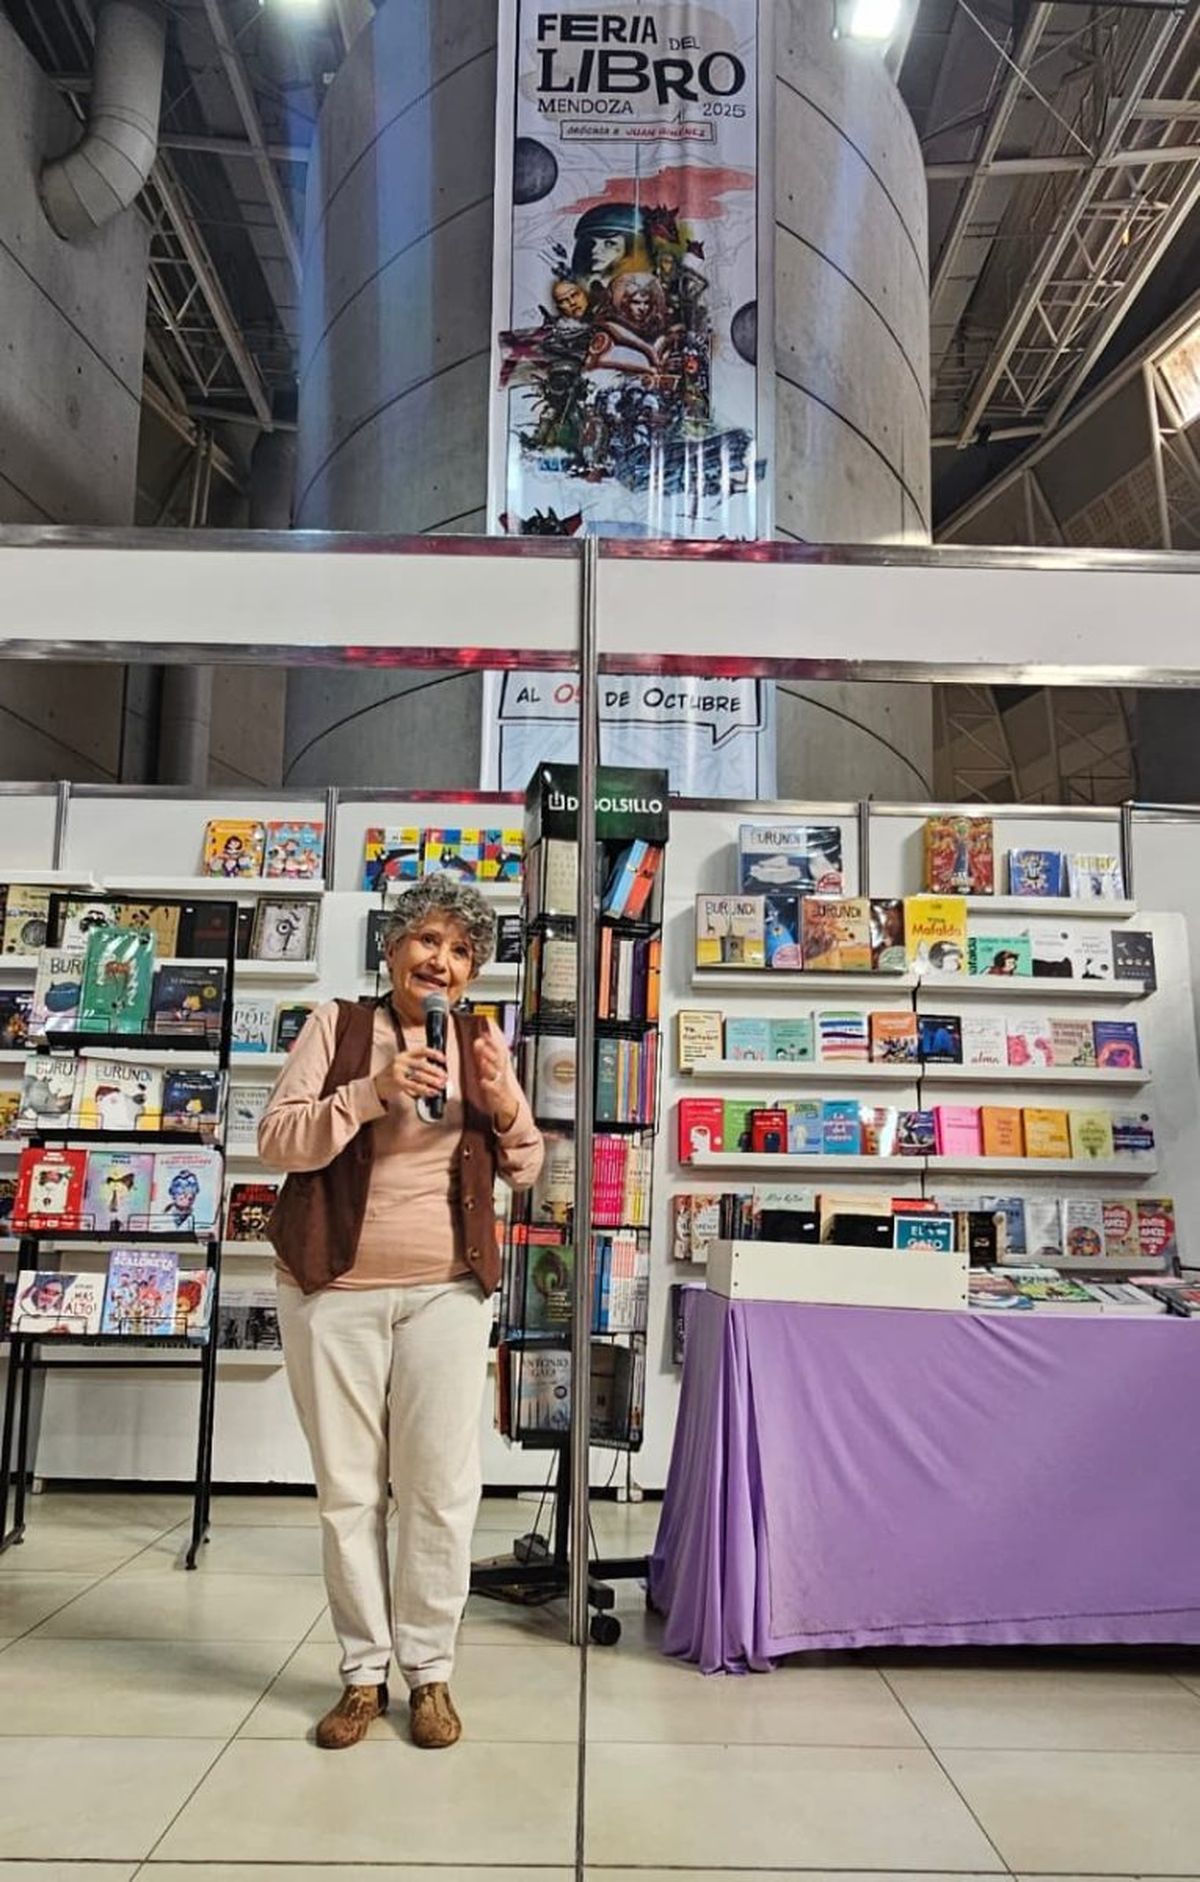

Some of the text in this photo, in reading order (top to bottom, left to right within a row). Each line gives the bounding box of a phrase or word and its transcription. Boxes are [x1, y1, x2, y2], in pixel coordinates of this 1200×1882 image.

[537, 14, 700, 50] FERIA DEL
[537, 48, 746, 105] LIBRO
[537, 98, 746, 118] MENDOZA 2025
[516, 687, 541, 704] AL
[604, 690, 631, 708] DE
[566, 797, 663, 814] DOLSILLO
